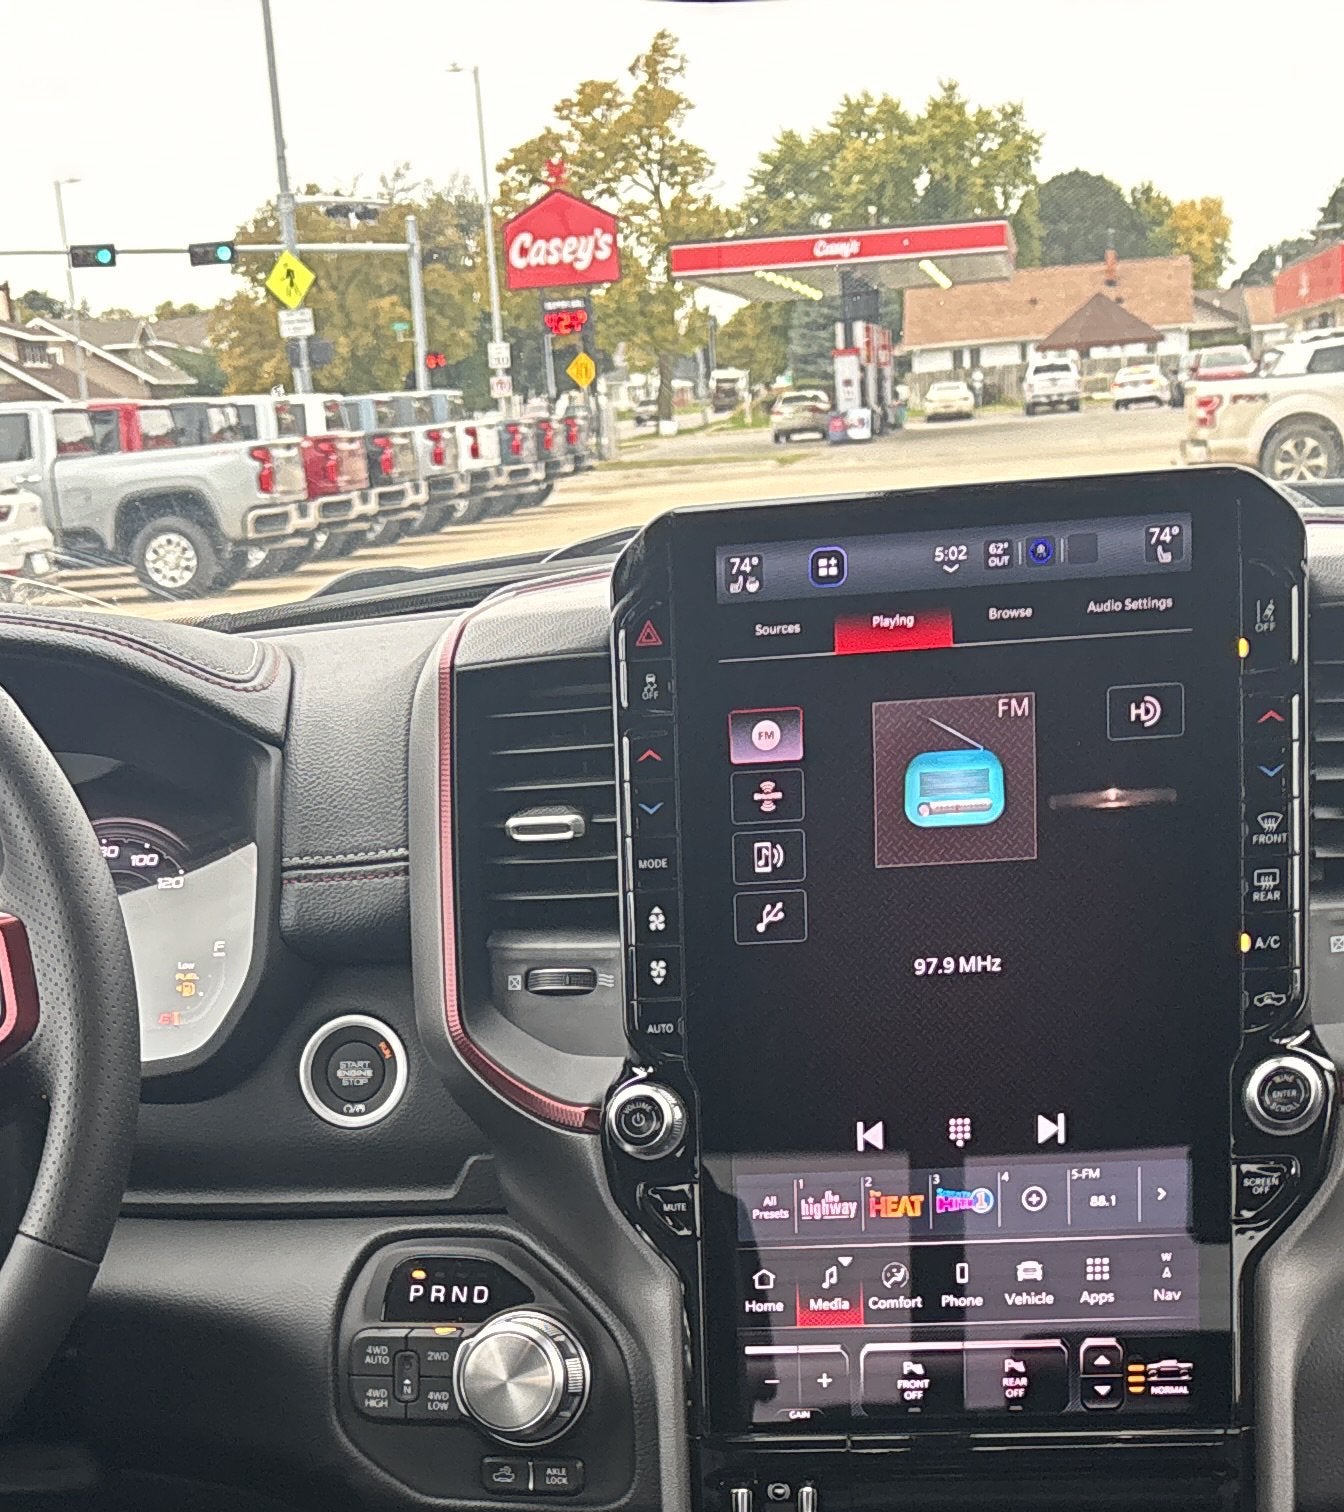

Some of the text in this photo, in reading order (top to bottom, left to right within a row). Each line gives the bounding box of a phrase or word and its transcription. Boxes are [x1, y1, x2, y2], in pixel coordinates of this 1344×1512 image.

[509, 227, 613, 271] Casey's
[934, 545, 968, 562] 5:02
[988, 555, 1010, 567] OUT
[1087, 597, 1173, 614] Audio Settings
[988, 606, 1033, 621] Browse
[872, 614, 915, 630] Playing
[1255, 622, 1276, 633] OFF
[755, 623, 801, 636] Sources
[642, 690, 659, 700] OFF
[998, 697, 1030, 718] FM
[758, 730, 775, 741] FM
[1252, 833, 1288, 844] FRONT
[130, 854, 158, 866] 100
[638, 858, 668, 869] MODE
[157, 877, 184, 889] 120
[1253, 889, 1281, 901] REAR
[213, 941, 226, 953] F
[1255, 935, 1281, 949] A/C
[914, 955, 1002, 975] 97.9 MHz
[646, 1023, 674, 1034] AUTO
[339, 1060, 371, 1069] START
[336, 1069, 374, 1077] ENGINE
[342, 1078, 369, 1086] STOP
[1272, 1089, 1297, 1099] ENTER
[622, 1102, 653, 1114] VOLUME
[932, 1173, 941, 1185] 3
[1001, 1171, 1009, 1182] 4
[1071, 1168, 1100, 1180] 5-FM
[798, 1178, 804, 1189] 1
[864, 1177, 873, 1188] 2
[1243, 1178, 1279, 1187] SCREEN
[1252, 1186, 1271, 1195] OFF
[663, 1202, 687, 1212] MUTE
[763, 1196, 777, 1207] All
[869, 1195, 925, 1218] HEAT
[752, 1208, 790, 1220] Presets
[800, 1197, 858, 1220] highway
[1004, 1291, 1055, 1306] Vehicle
[1079, 1290, 1115, 1306] Apps
[1153, 1288, 1182, 1302] Nav
[744, 1300, 784, 1313] Home
[809, 1297, 850, 1311] Media
[868, 1296, 923, 1310] Comfort
[941, 1294, 984, 1308] Phone
[365, 1345, 389, 1355] 4WD
[364, 1355, 390, 1365] AUTO
[427, 1351, 450, 1361] 2WD
[897, 1378, 930, 1389] FRONT
[1002, 1377, 1028, 1387] REAR
[365, 1388, 388, 1398] 4WD
[903, 1390, 923, 1400] OFF
[1005, 1388, 1025, 1399] OFF
[1150, 1385, 1190, 1395] NORMAL
[427, 1391, 450, 1401] 4WD
[364, 1398, 389, 1408] HIGH
[427, 1401, 450, 1411] LOW
[545, 1476, 568, 1485] LOCK
